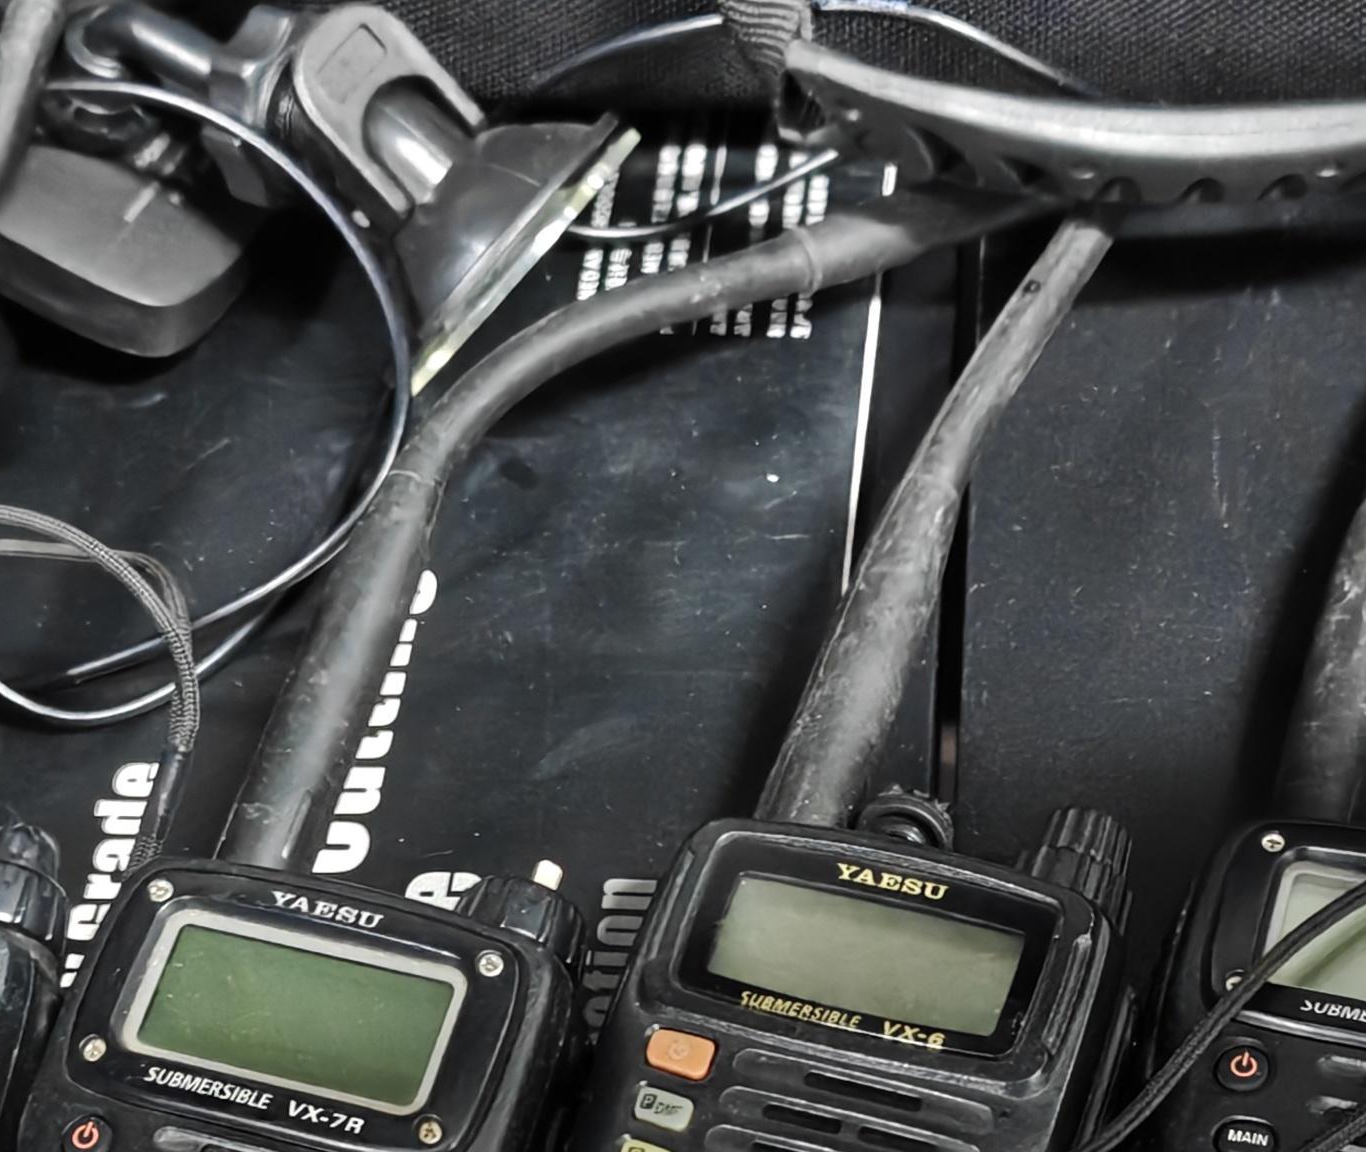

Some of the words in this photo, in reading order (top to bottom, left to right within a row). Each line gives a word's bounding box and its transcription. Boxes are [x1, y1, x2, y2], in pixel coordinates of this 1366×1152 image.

[836, 862, 949, 901] YAESU
[271, 890, 384, 930] YAESU
[740, 990, 862, 1030] SUBMERSIBLE
[882, 1021, 946, 1049] VX-6
[144, 1066, 273, 1110] SUBMERSIBLE
[287, 1100, 366, 1135] VX-7R
[1228, 1129, 1268, 1146] MAIN
